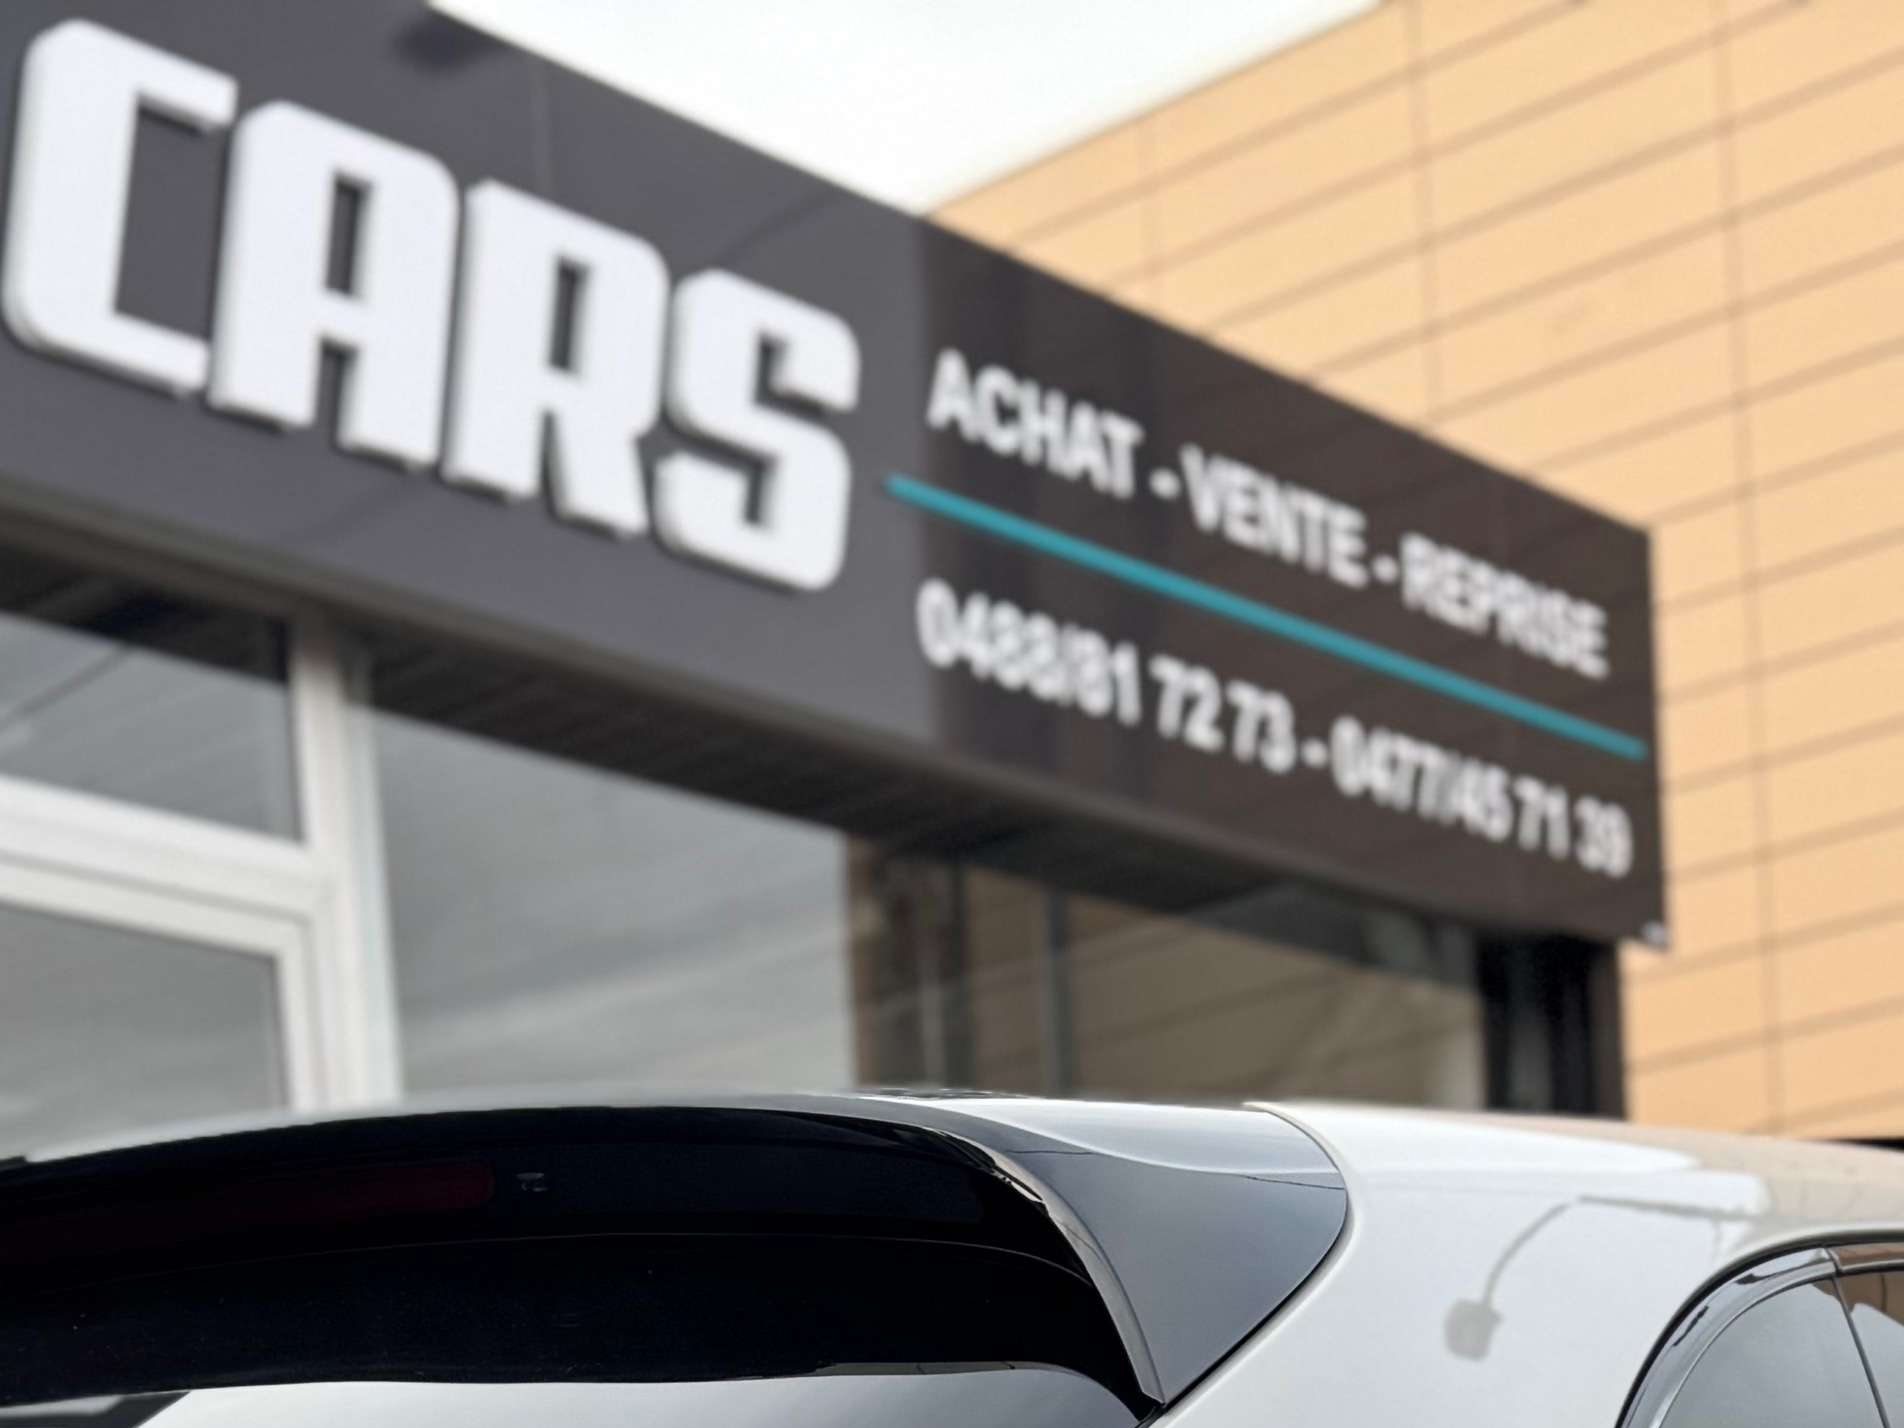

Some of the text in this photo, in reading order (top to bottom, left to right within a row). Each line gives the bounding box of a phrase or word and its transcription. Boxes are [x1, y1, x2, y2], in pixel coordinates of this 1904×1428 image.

[0, 18, 861, 591] CARS
[926, 347, 1144, 499] ACHAT
[1181, 443, 1369, 589] VENTE
[1401, 531, 1609, 681] REPRISE
[916, 577, 1143, 727] 0488/81
[1147, 653, 1225, 753] 72
[1226, 680, 1297, 775] 73
[1512, 774, 1571, 861] 71
[1574, 795, 1635, 879] 39
